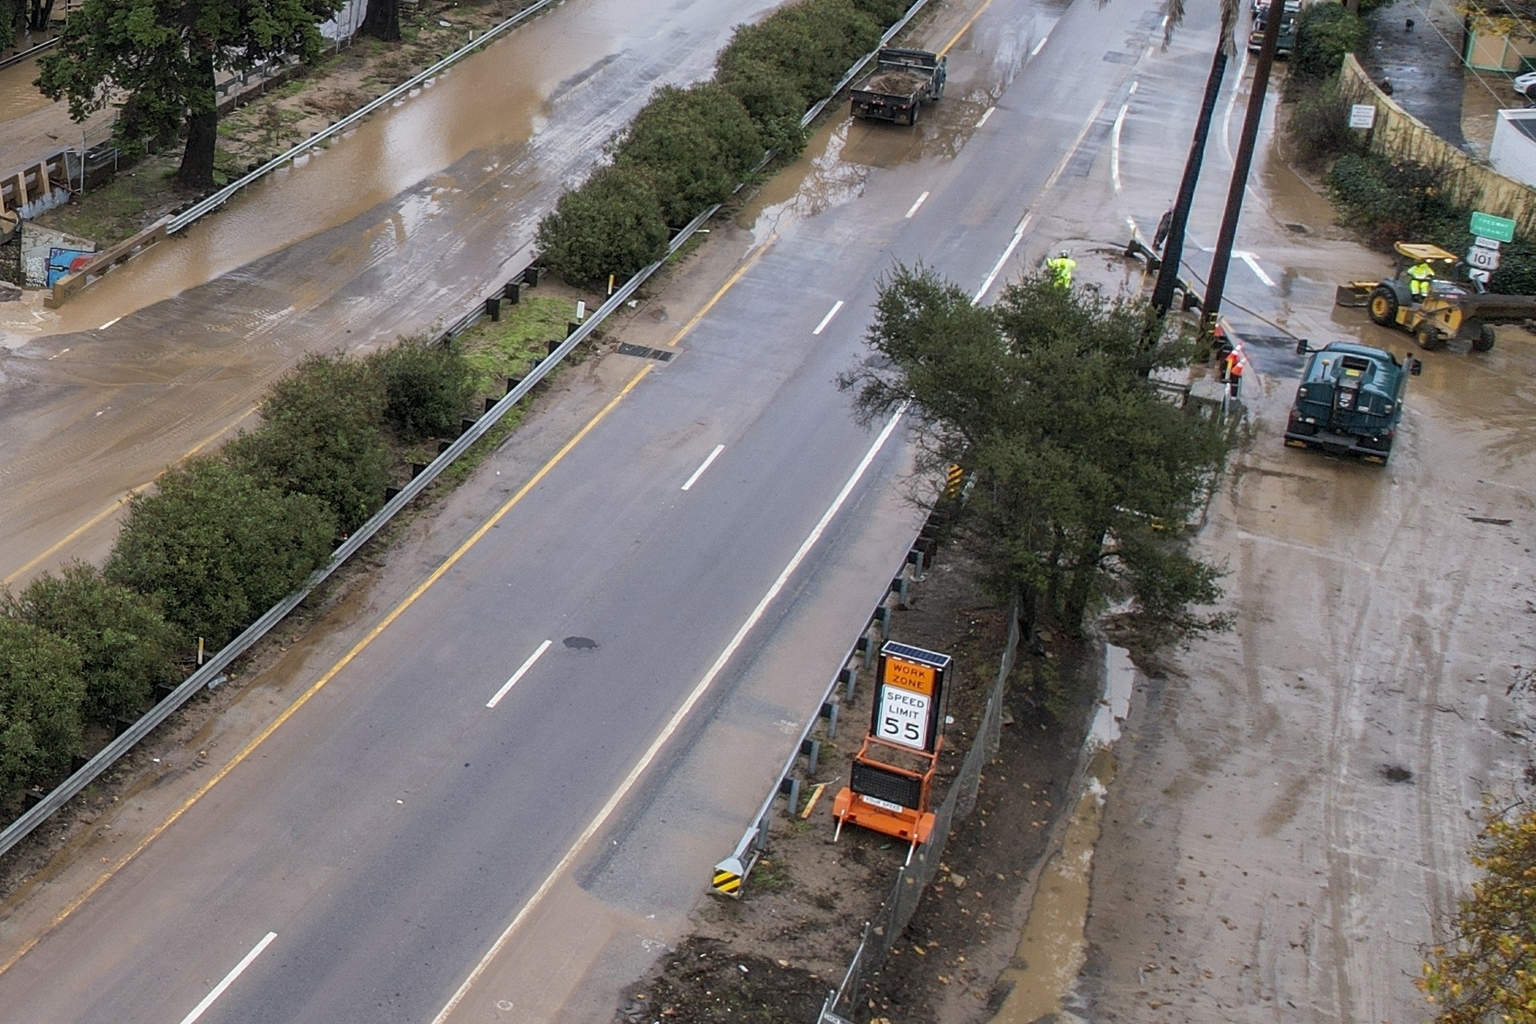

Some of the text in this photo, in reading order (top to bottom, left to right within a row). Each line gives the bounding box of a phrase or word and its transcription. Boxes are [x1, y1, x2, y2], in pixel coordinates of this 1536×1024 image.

[1478, 238, 1497, 247] SOUTH
[1473, 253, 1491, 266] 101
[893, 663, 926, 679] WORK
[892, 674, 924, 690] ZONE
[886, 691, 925, 708] SPEED
[888, 704, 919, 719] LIMIT
[883, 716, 920, 741] 55
[866, 797, 901, 811] YOUR SPEED
